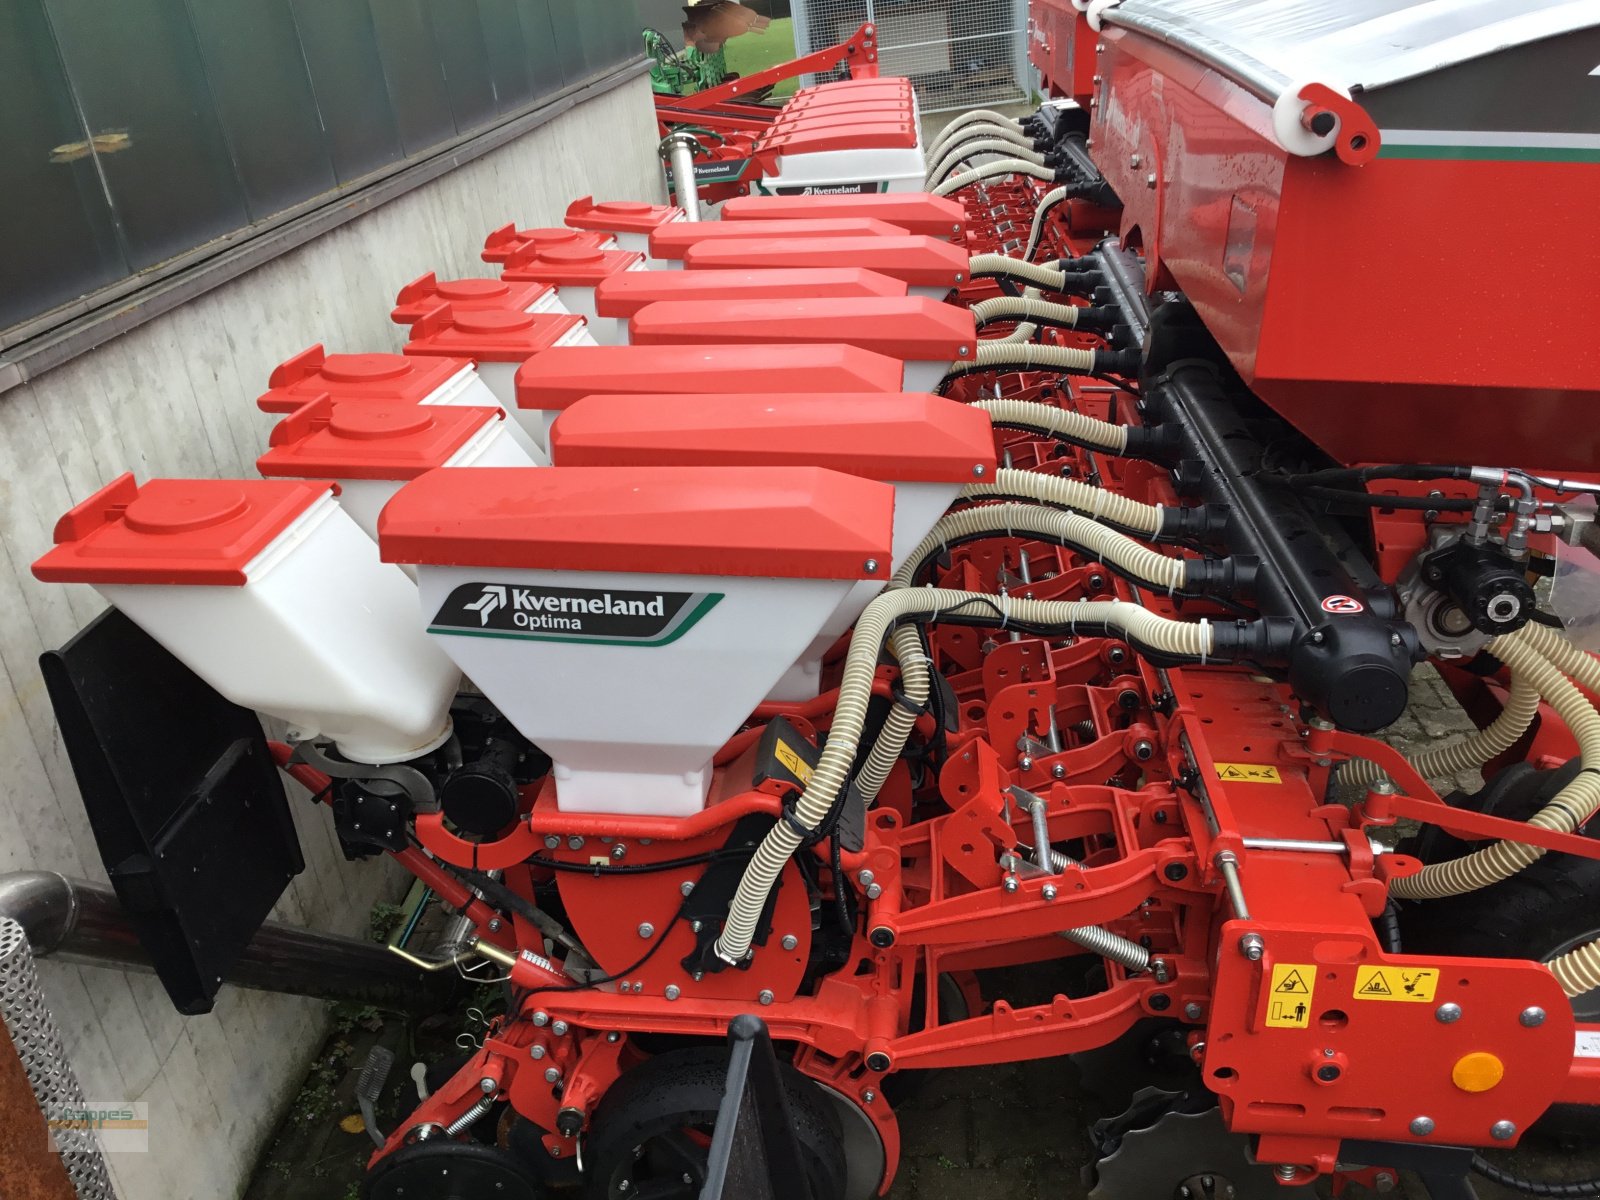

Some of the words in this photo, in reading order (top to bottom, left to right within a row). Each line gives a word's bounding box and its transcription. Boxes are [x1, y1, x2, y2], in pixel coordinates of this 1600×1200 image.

[698, 165, 730, 174] Kverneland
[813, 185, 861, 195] Kverneland
[512, 589, 664, 617] Kverneland
[513, 612, 582, 632] Optima
